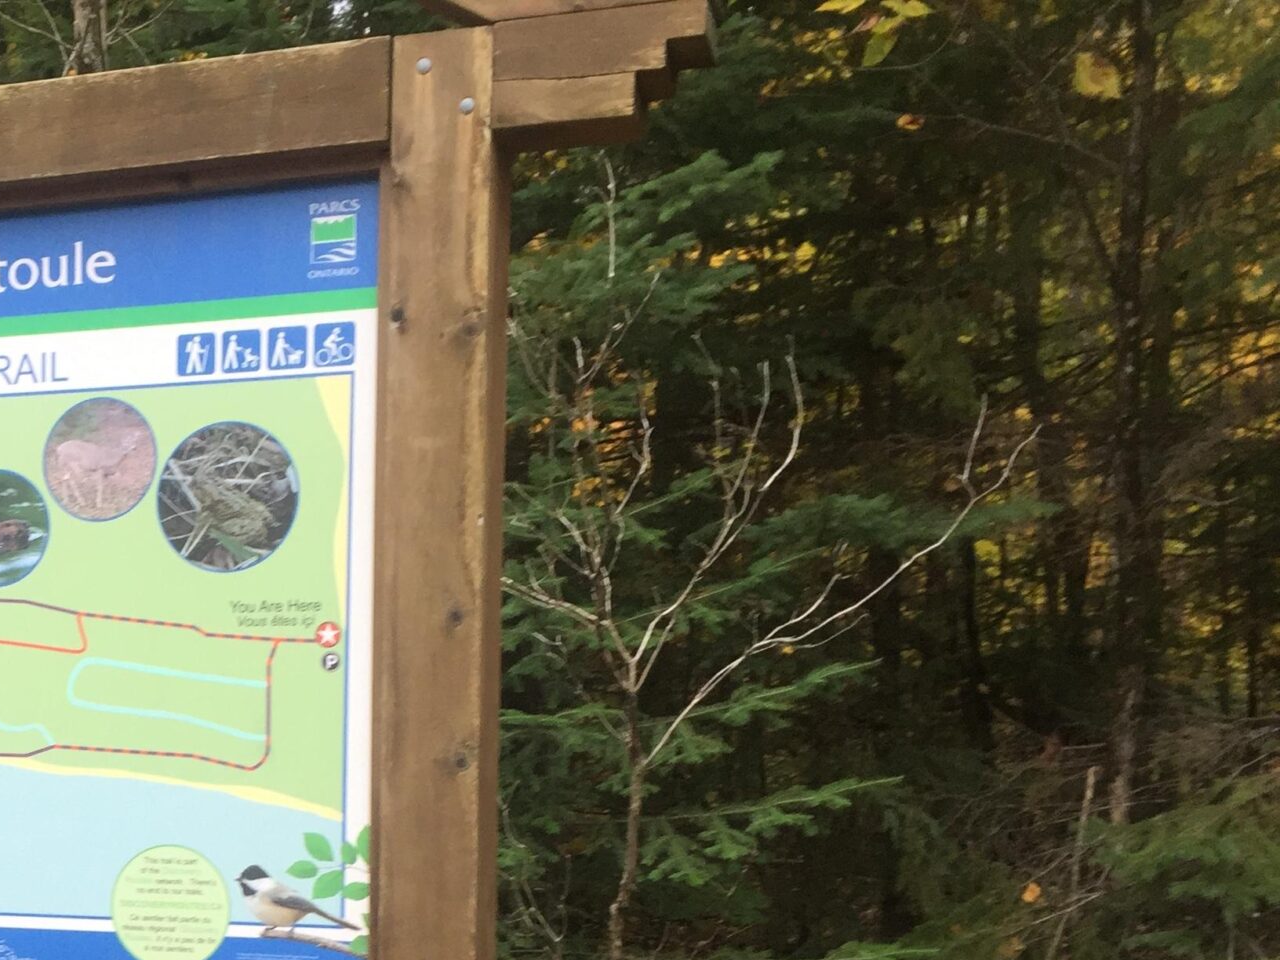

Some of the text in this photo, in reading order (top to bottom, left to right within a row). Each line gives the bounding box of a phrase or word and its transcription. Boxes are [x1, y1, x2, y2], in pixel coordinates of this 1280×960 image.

[309, 199, 361, 216] PARCS
[230, 600, 321, 613] You Are Here
